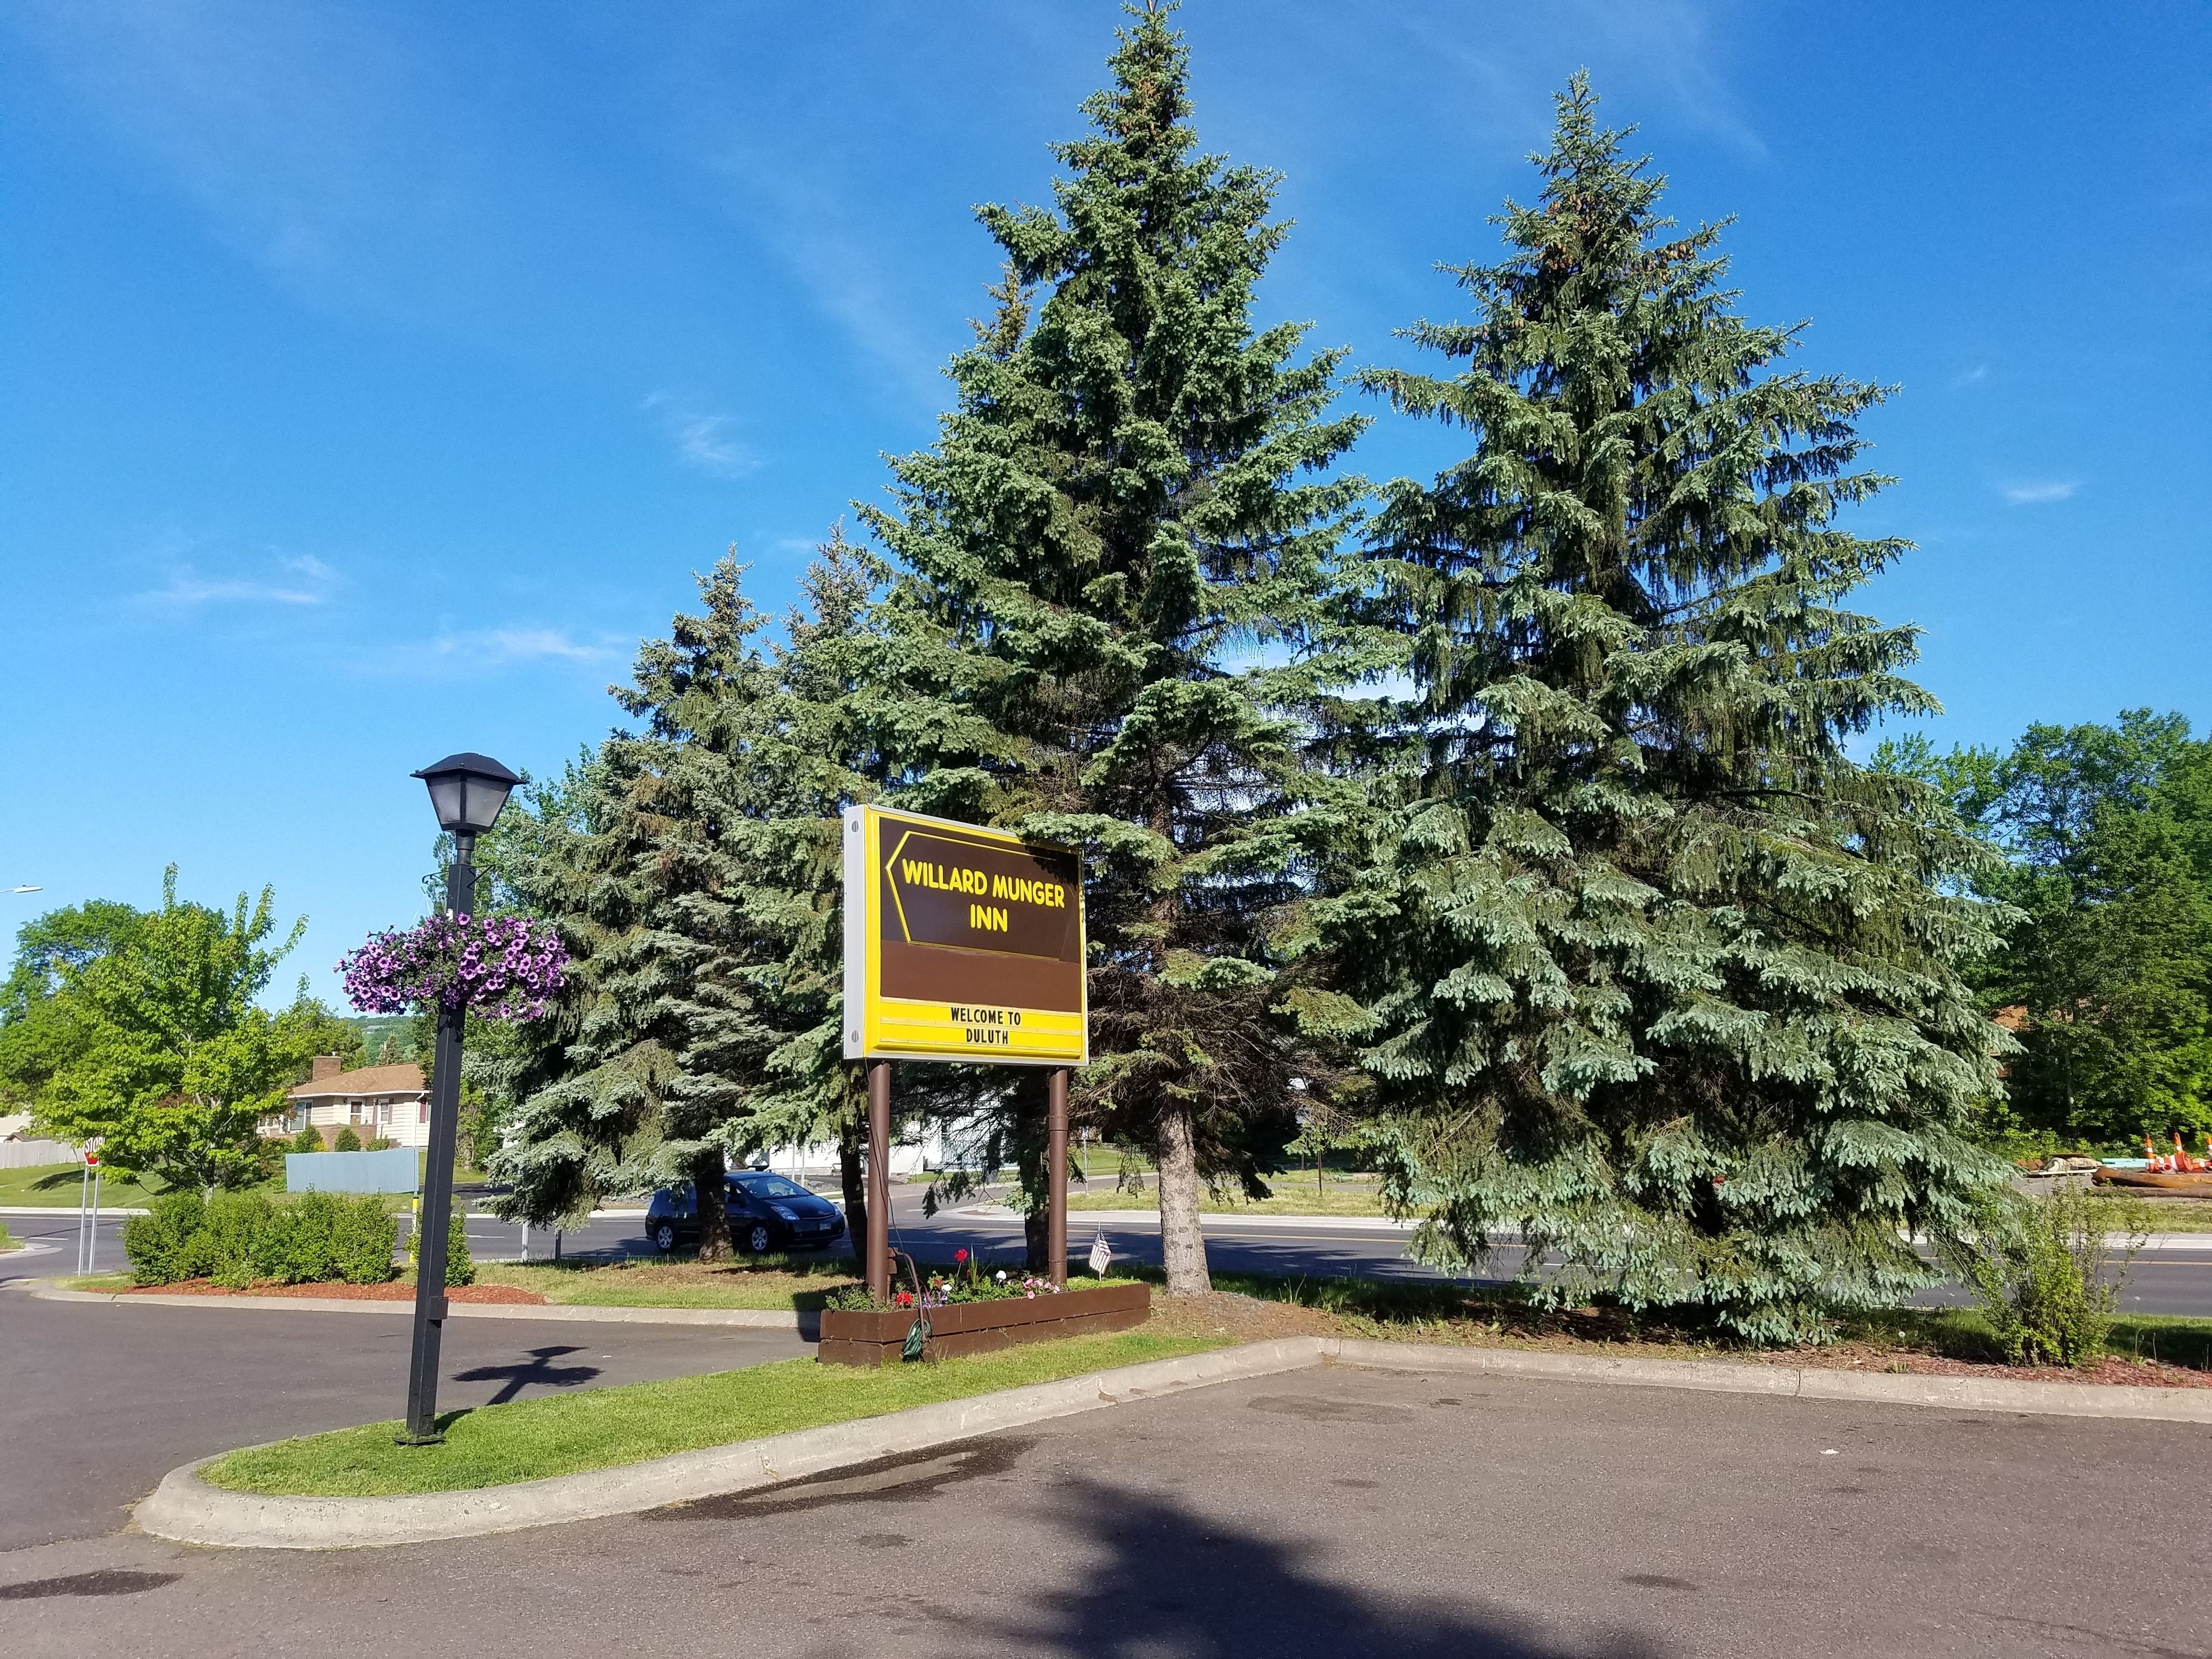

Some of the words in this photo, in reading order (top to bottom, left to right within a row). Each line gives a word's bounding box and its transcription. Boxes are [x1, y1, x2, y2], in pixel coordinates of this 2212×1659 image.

[902, 858, 987, 895] WILLARD
[992, 874, 1065, 908] MUNGER
[971, 904, 1008, 933] INN
[951, 1007, 1003, 1025] WELCOME
[1008, 1012, 1021, 1025] TO
[966, 1028, 1008, 1044] DULUTH
